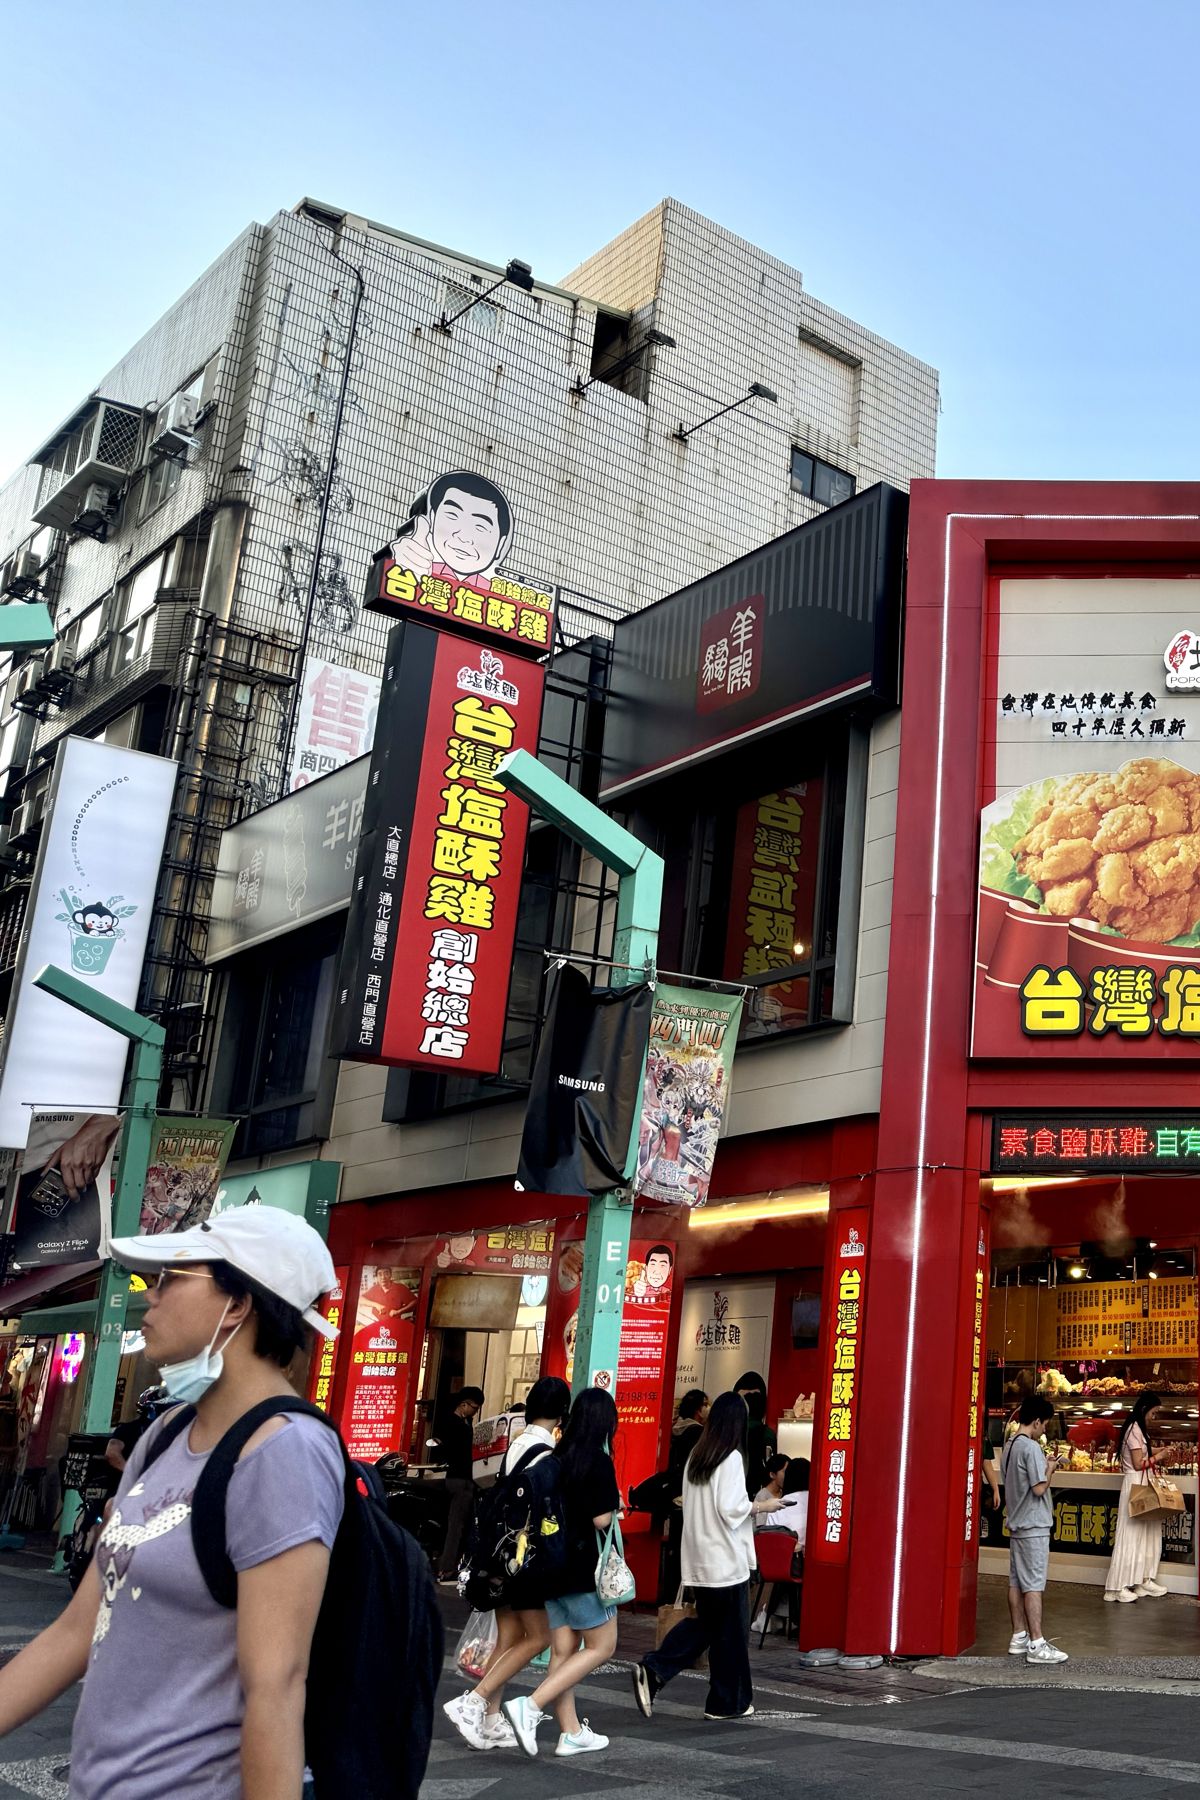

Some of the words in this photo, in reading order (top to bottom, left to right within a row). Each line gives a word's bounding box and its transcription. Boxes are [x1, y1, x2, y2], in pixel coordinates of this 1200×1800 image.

[490, 577, 552, 610] 創始總店
[386, 565, 549, 643] 台灣塩酥雞
[1001, 691, 1157, 711] 台灣在地傳統美食
[424, 695, 517, 929] 台灣塩酥雞
[419, 928, 480, 1059] 創始總店
[558, 1074, 605, 1093] SAMSUNG
[35, 1114, 75, 1123] SAMSUNG
[37, 1241, 65, 1249] Galaxy
[487, 1231, 554, 1252] 台灣塩
[606, 1242, 620, 1261] E
[512, 1254, 551, 1269] 創始總
[110, 1294, 123, 1307] E
[598, 1285, 622, 1304] 01
[103, 1323, 122, 1336] 03
[827, 1269, 861, 1442] 台灣塩酥雞
[825, 1449, 846, 1543] 創始總店
